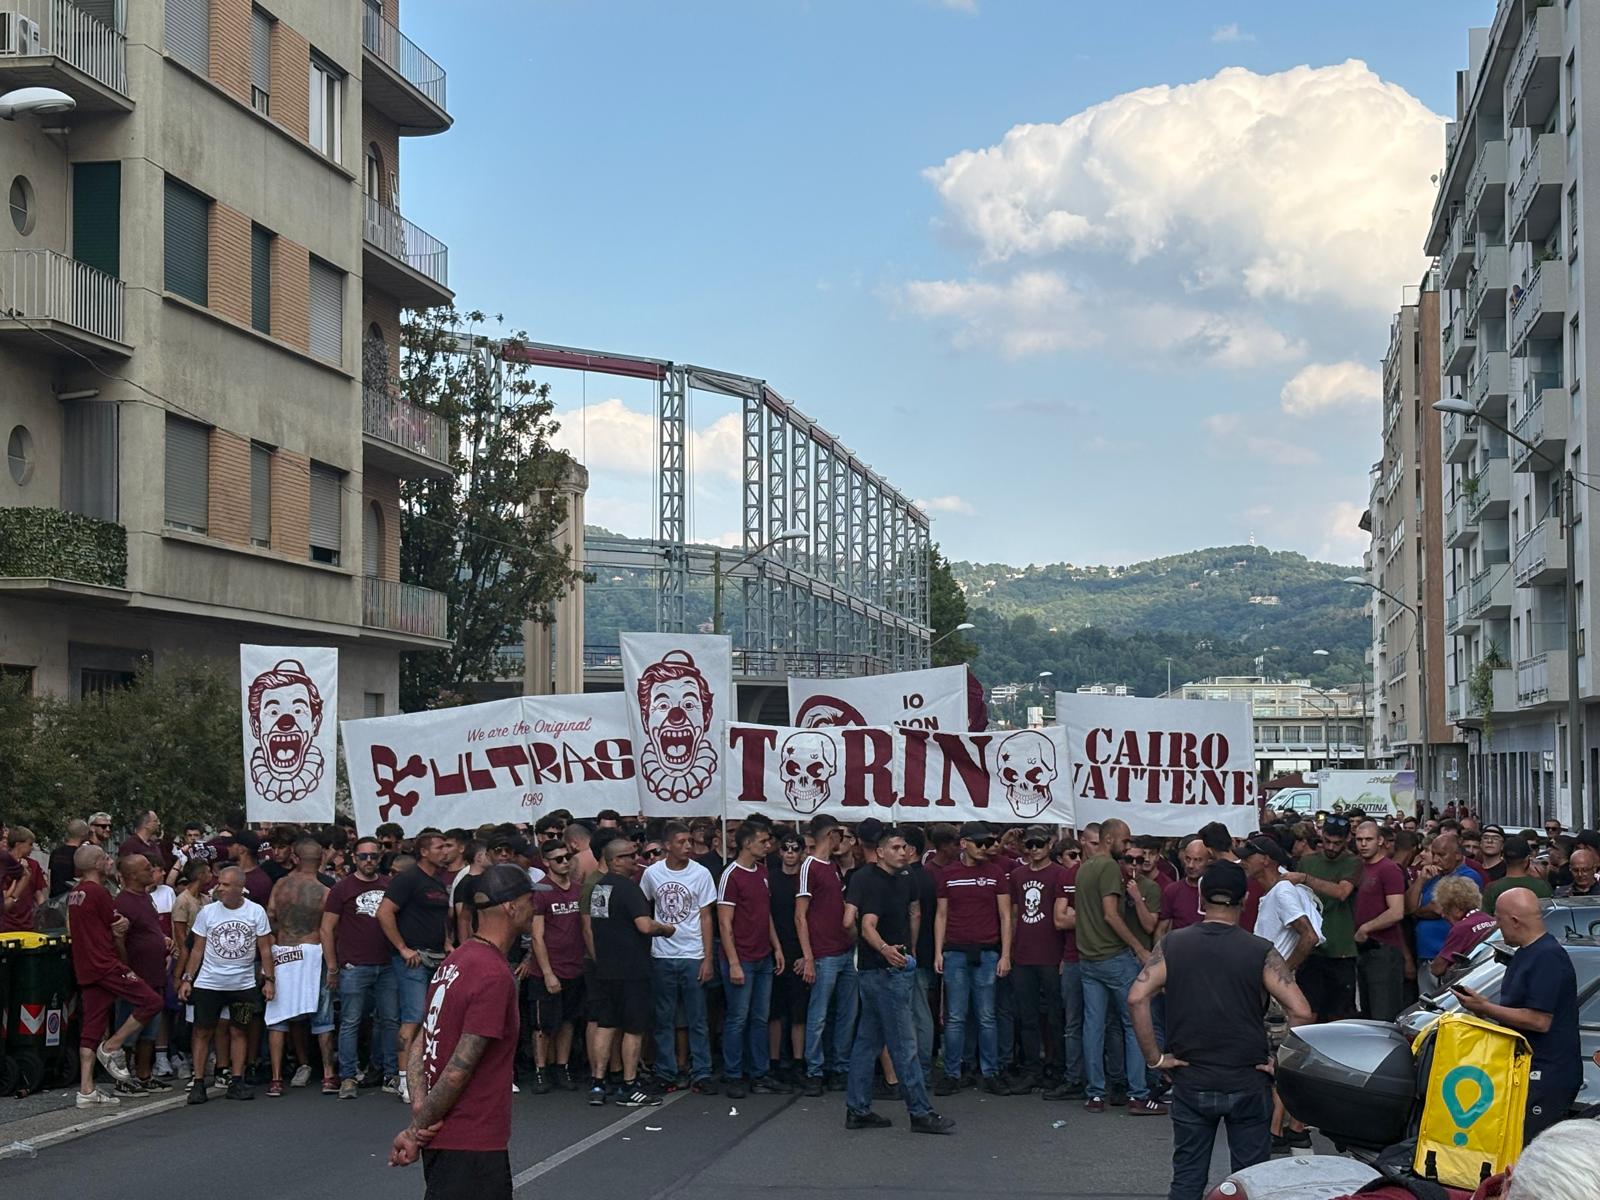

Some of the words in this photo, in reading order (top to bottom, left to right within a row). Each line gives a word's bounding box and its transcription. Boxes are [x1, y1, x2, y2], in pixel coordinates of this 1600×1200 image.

[902, 693, 925, 710] IO
[467, 728, 485, 743] We
[488, 727, 510, 739] are
[513, 720, 531, 736] the
[535, 717, 592, 740] Original
[1085, 727, 1230, 770] CAIRO
[429, 738, 636, 796] ULTRAS
